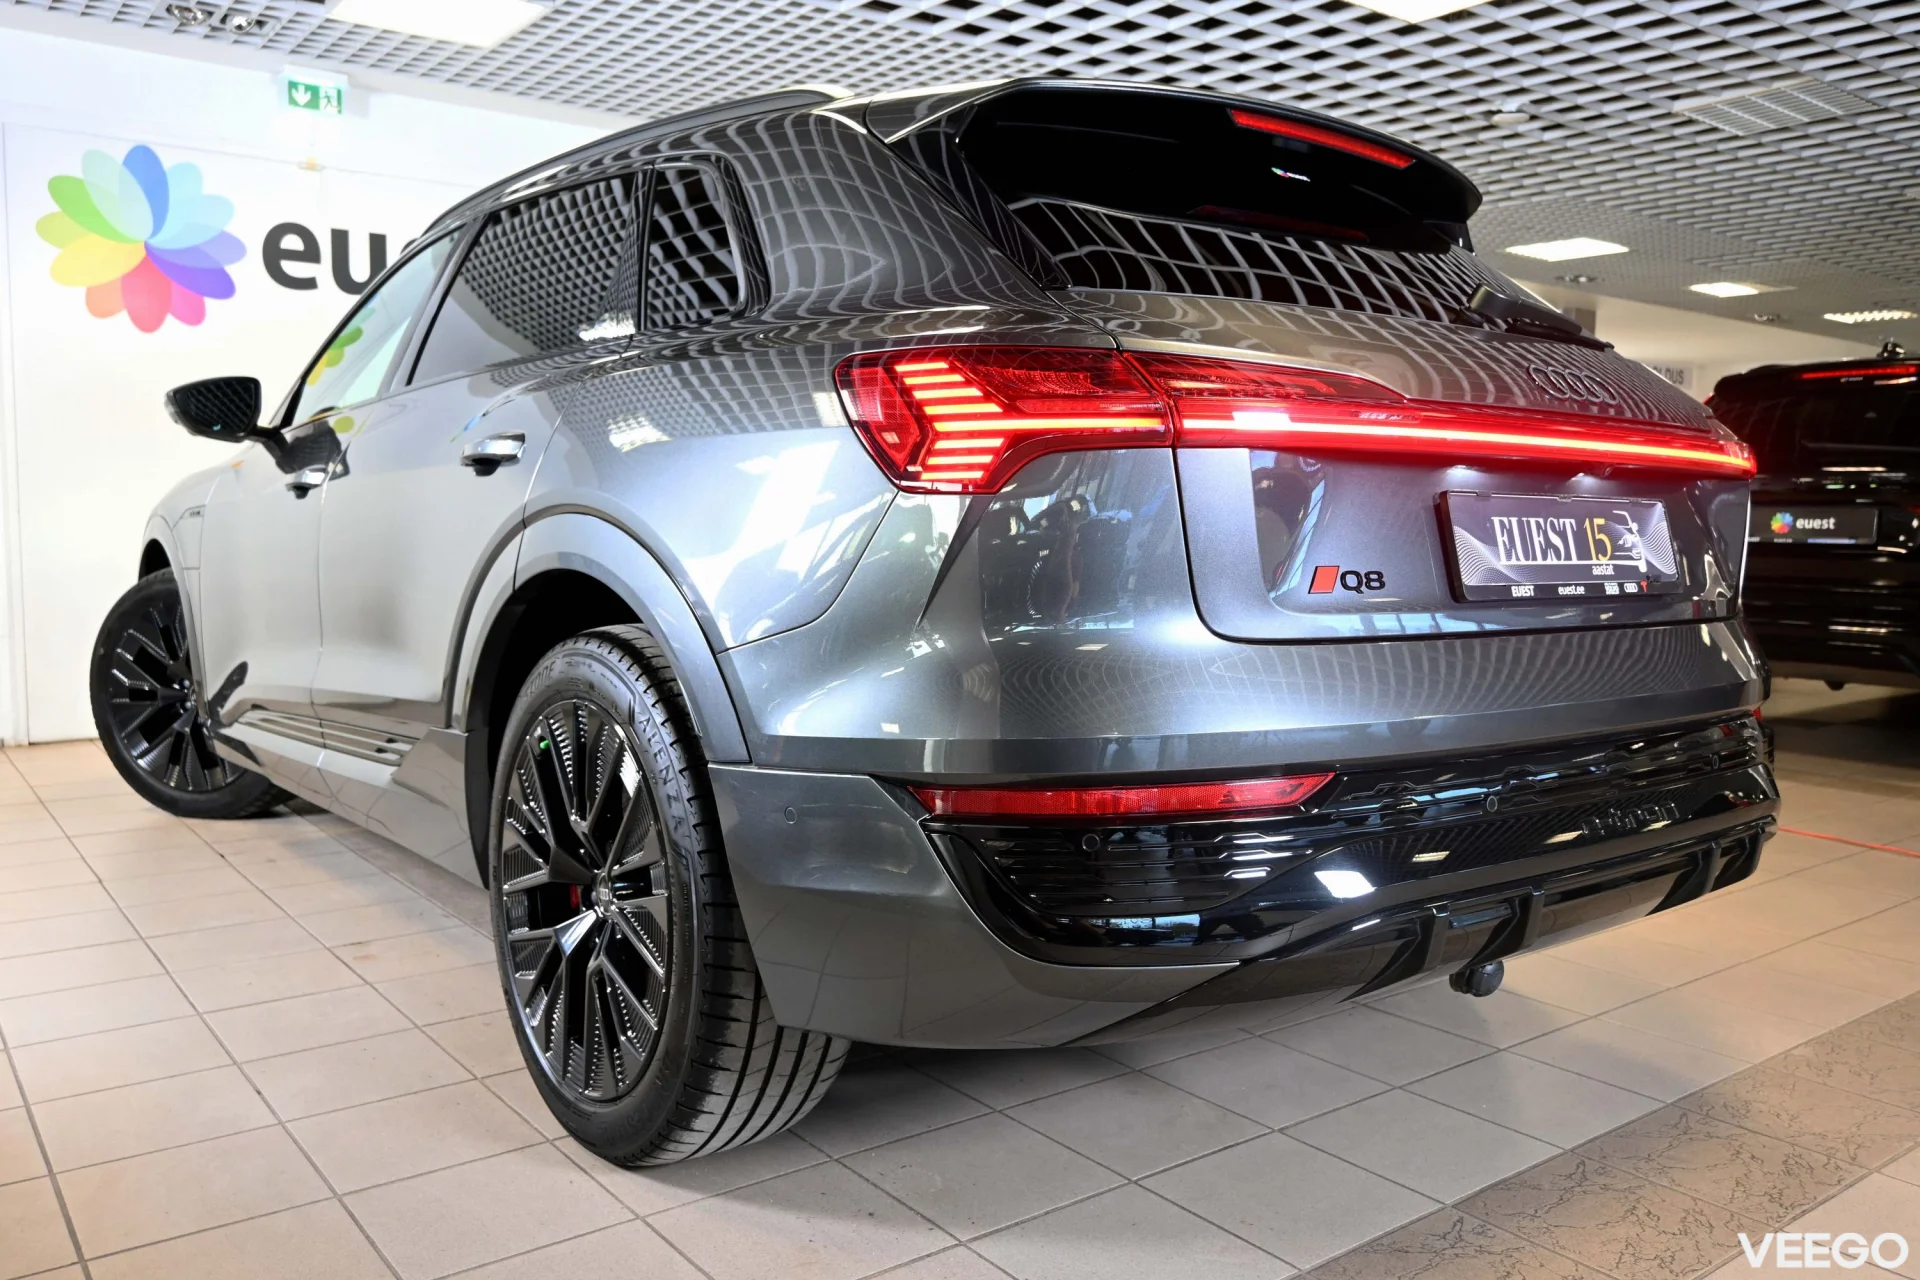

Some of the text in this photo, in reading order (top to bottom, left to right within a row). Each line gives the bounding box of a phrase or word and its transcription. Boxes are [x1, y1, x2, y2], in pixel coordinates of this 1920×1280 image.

[262, 222, 418, 296] eu
[1795, 517, 1836, 530] euest
[1491, 516, 1612, 562] EUEST 15
[1591, 564, 1615, 576] aastat
[1340, 570, 1386, 594] Q8
[1511, 585, 1534, 597] EUEST
[1558, 585, 1585, 595] euest.ee
[638, 716, 686, 835] ALENZA
